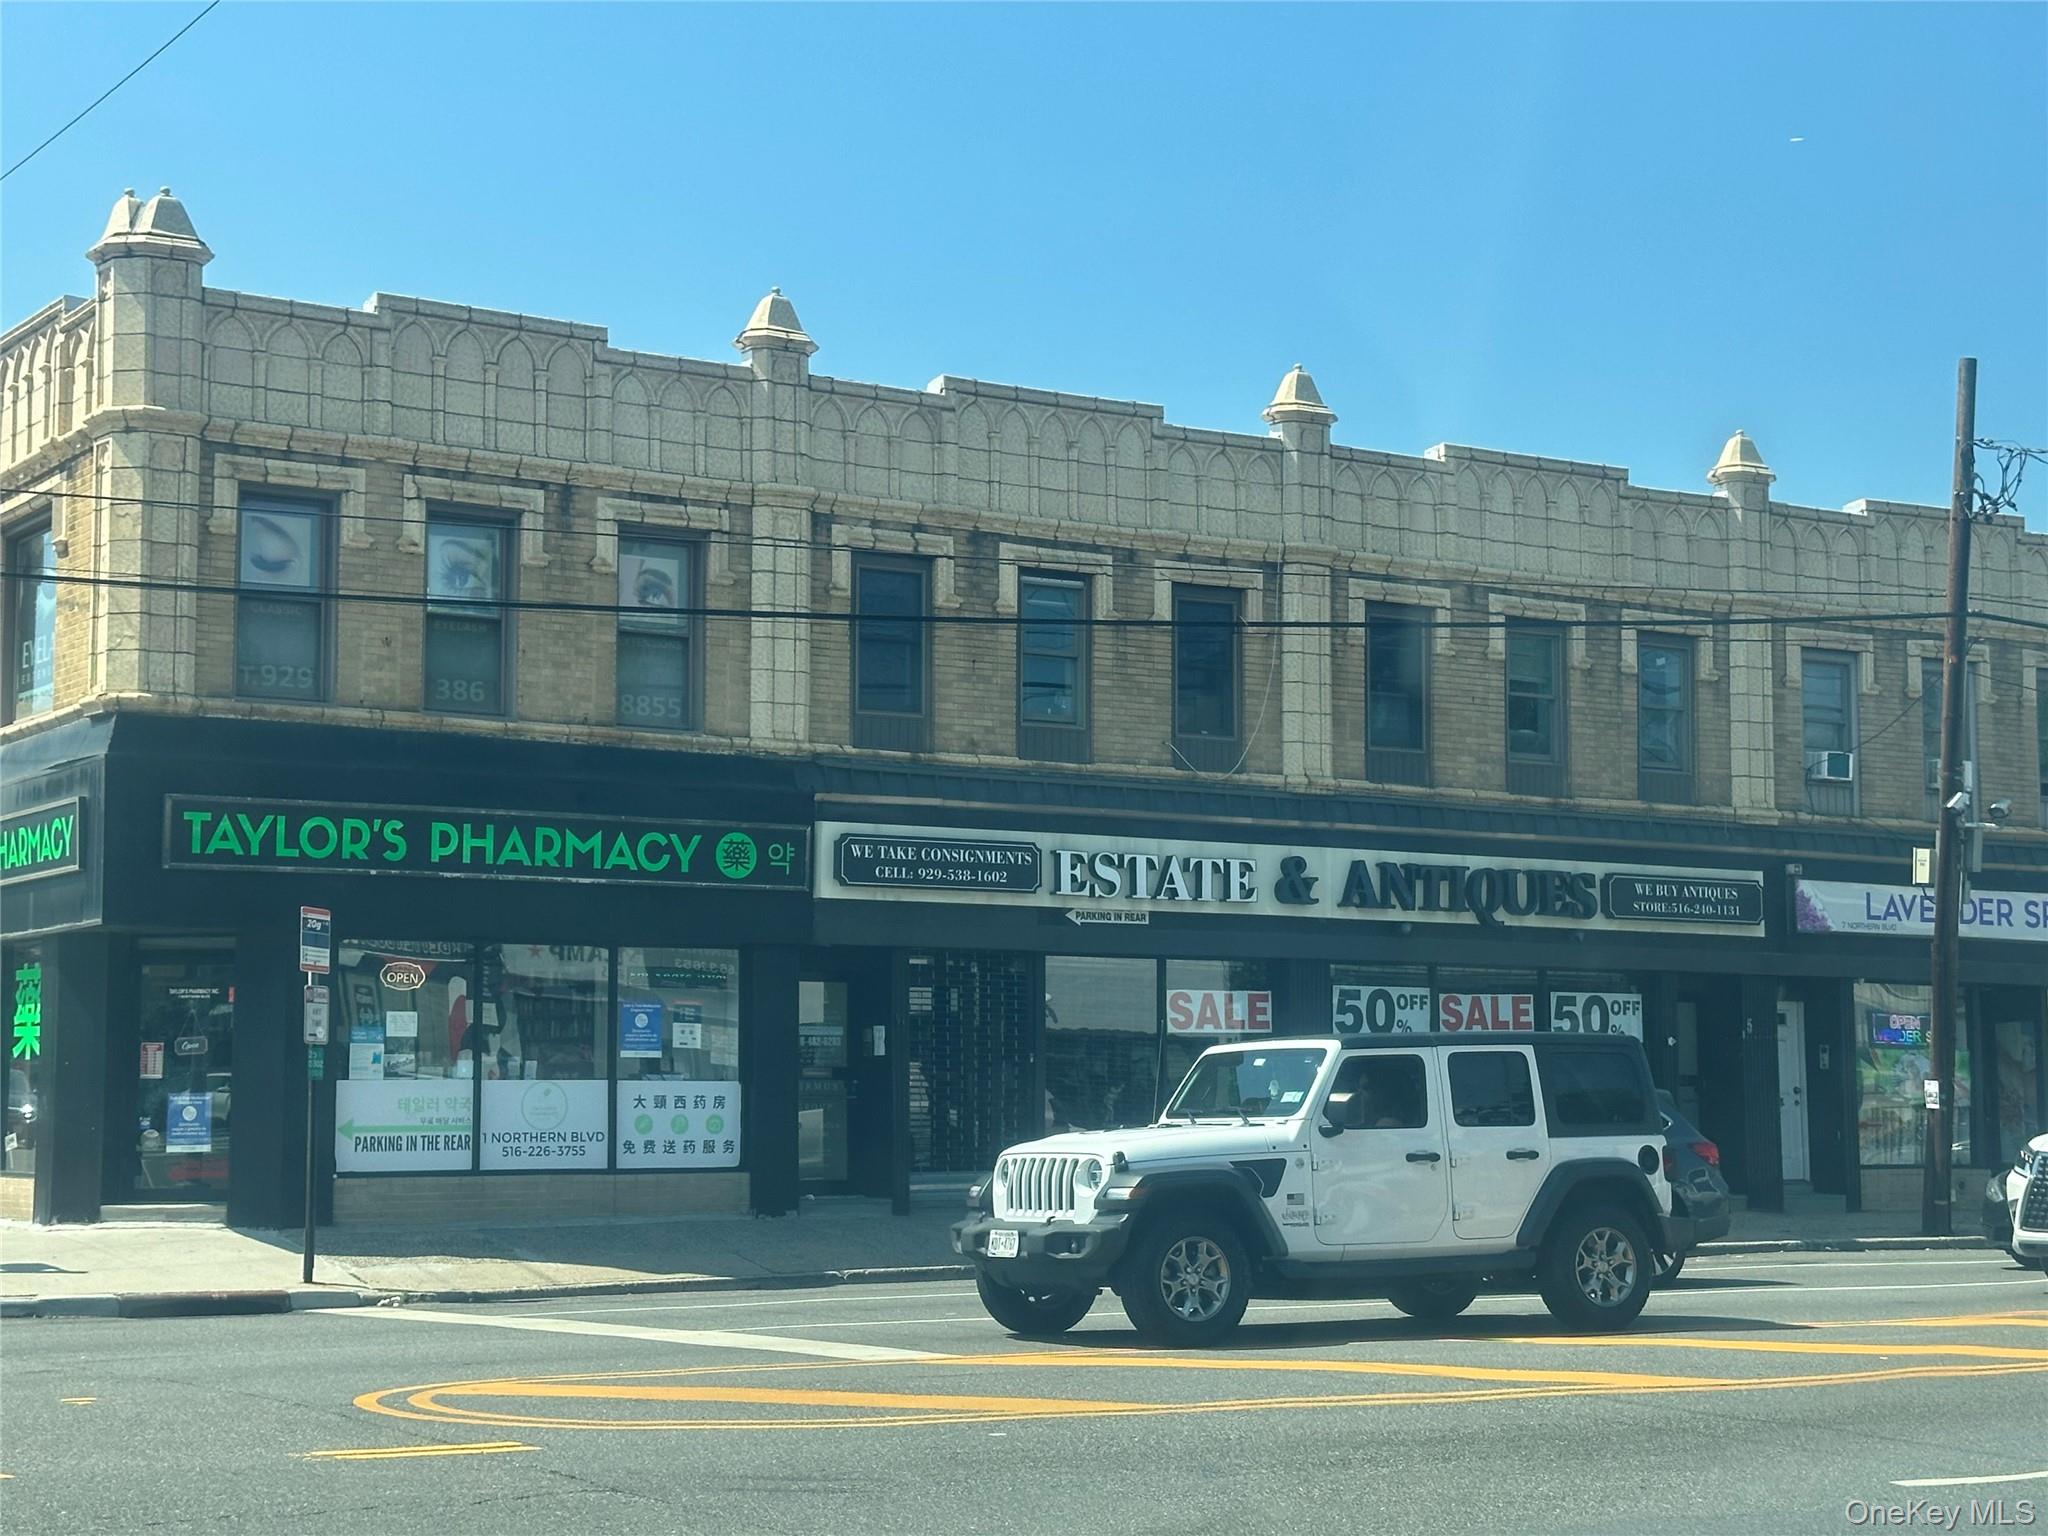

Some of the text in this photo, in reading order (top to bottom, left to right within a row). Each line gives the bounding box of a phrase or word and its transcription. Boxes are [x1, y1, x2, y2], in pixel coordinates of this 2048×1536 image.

[435, 678, 485, 702] 386
[620, 694, 681, 718] 8855
[183, 811, 702, 873] TAYLOR'S PHARMACY
[767, 842, 796, 876] 약
[851, 844, 1033, 866] WE TAKE CONSIGNMENTS
[875, 866, 1008, 883] CELL: 929-538-1602
[1055, 850, 1600, 928] ESTATE & ANTIQUES
[1634, 883, 1738, 901] WE BUY ANTIQUES
[1075, 911, 1147, 922] PARKING IN REAR
[1866, 891, 2014, 927] LAVEDER
[387, 972, 419, 983] OPEN
[1169, 991, 1270, 1031] SALE
[1334, 988, 1429, 1033] 50 OFF
[1440, 994, 1534, 1032] SALE
[1553, 995, 1641, 1033] 50 OFF
[1890, 1014, 1920, 1029] OPEN
[354, 1134, 471, 1152] PARKING IN THE REAR
[491, 1132, 567, 1143] NORTHERN
[570, 1131, 605, 1142] BLVD
[622, 1139, 735, 1154] 免费送药服务
[502, 1145, 586, 1158] 516-226-3755
